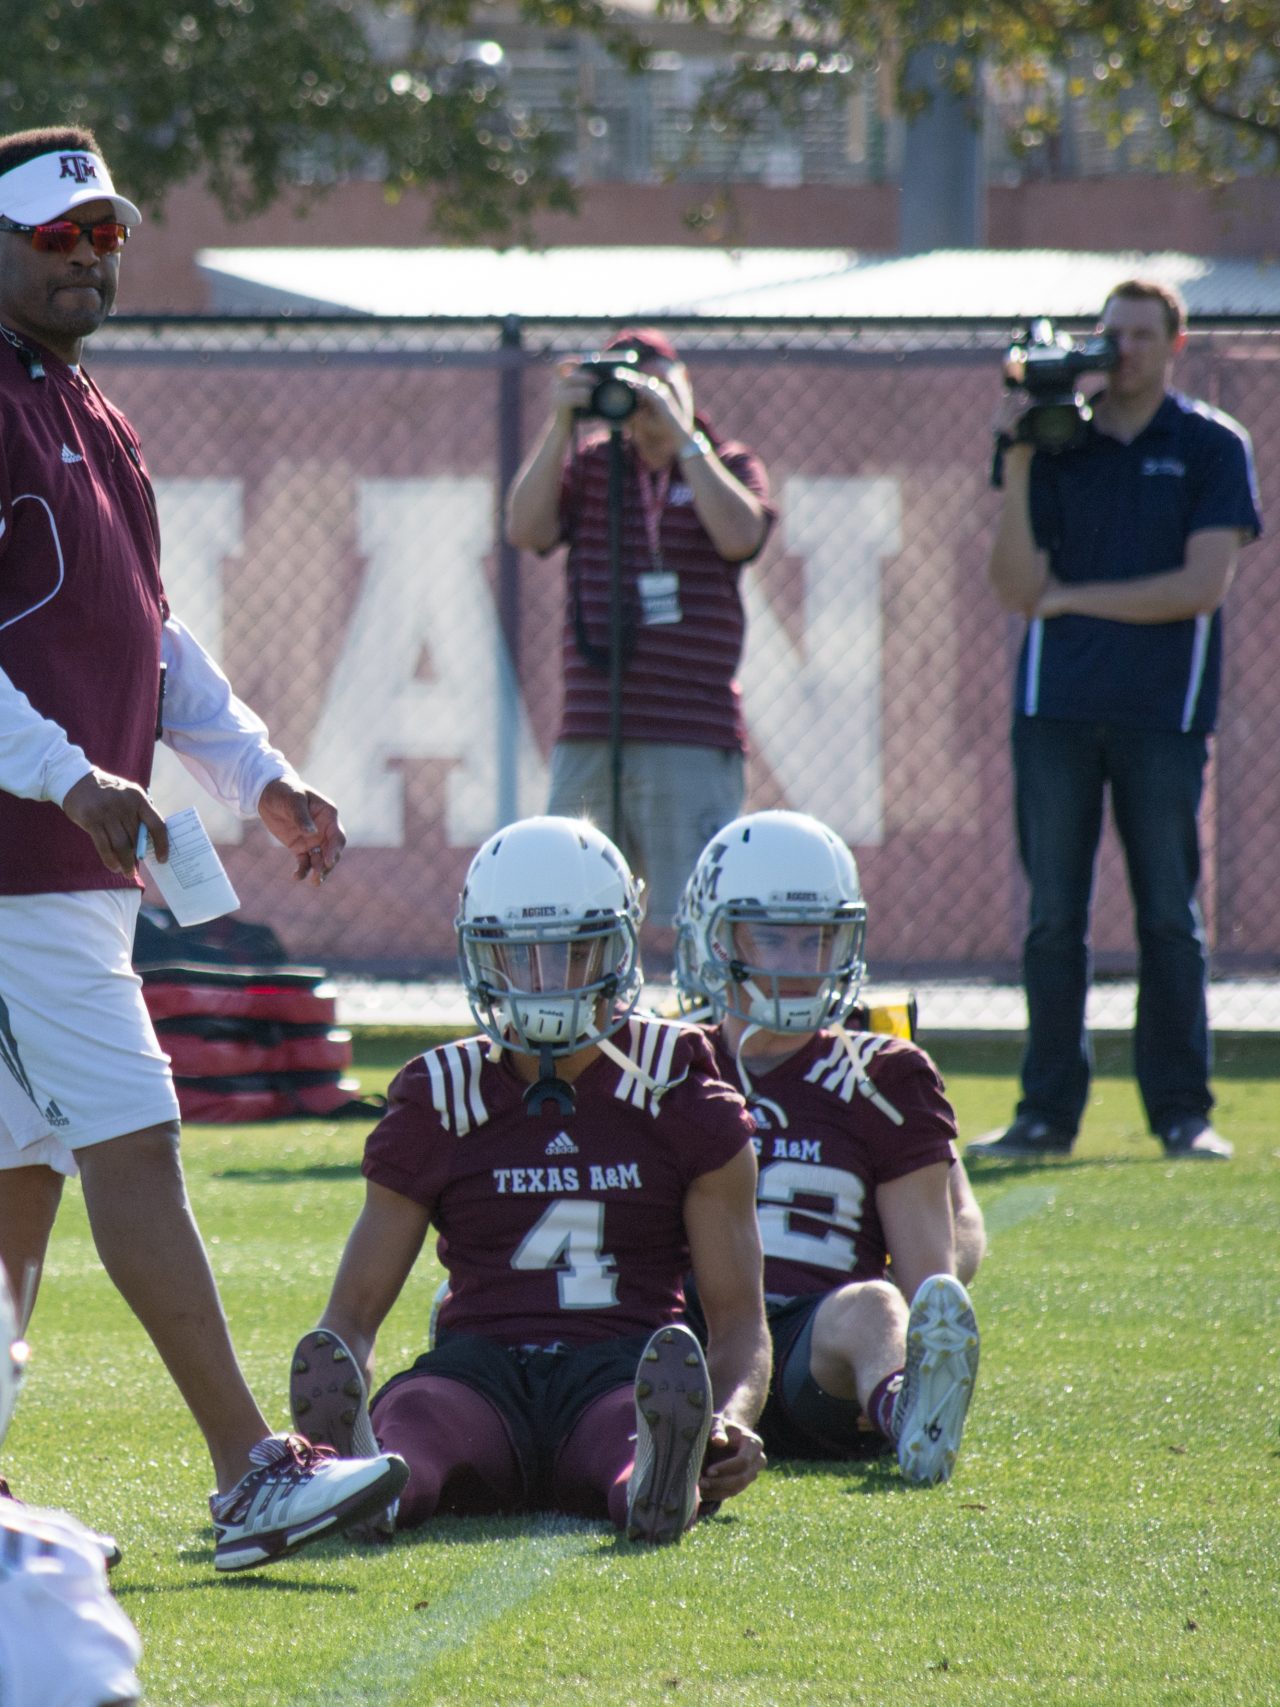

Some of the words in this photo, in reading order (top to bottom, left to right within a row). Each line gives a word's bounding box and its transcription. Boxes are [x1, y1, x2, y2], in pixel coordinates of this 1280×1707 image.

[522, 906, 556, 919] AGGIES
[544, 1145, 579, 1156] adidas
[772, 1138, 822, 1163] A&M
[492, 1166, 581, 1194] TEXAS
[589, 1161, 643, 1191] A&M
[509, 1198, 621, 1311] 4
